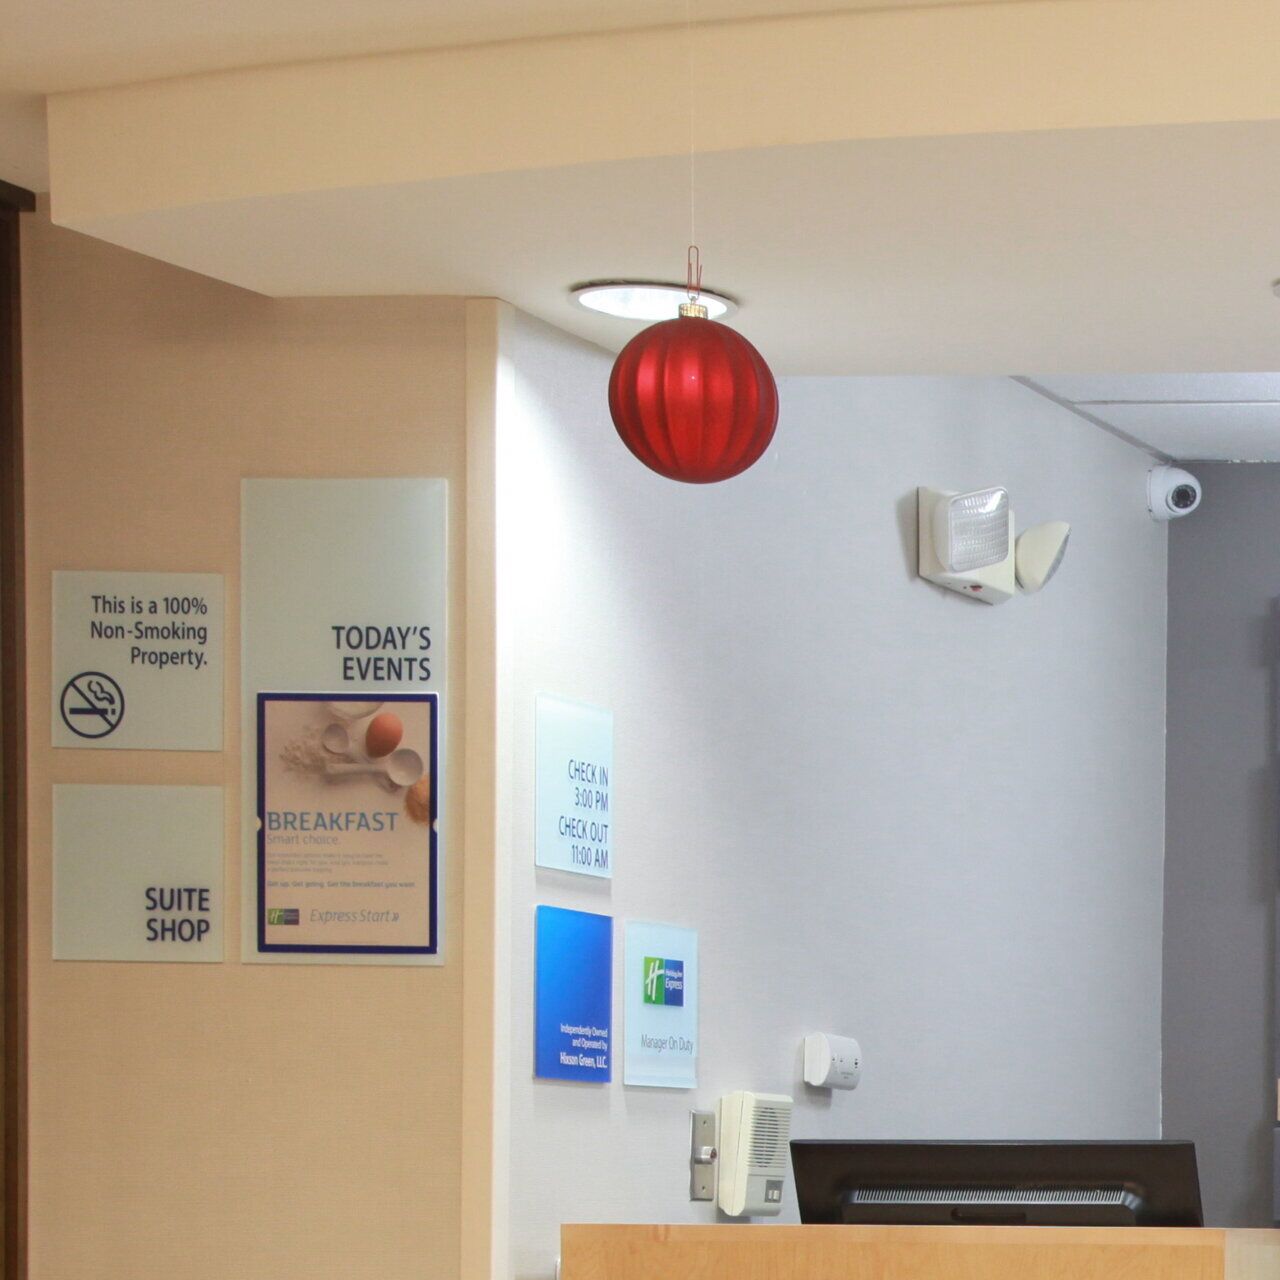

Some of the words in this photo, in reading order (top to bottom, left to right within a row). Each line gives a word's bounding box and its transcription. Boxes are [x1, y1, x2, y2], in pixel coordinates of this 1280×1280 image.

[91, 595, 125, 614] This
[131, 596, 143, 614] is
[149, 600, 157, 614] a
[163, 597, 207, 615] 100%
[90, 621, 207, 645] Non-Smoking
[331, 625, 431, 651] TODAY'S
[131, 646, 207, 670] Property.
[343, 656, 431, 681] EVENTS
[568, 759, 597, 784] CHECK
[599, 766, 608, 787] IN
[575, 786, 593, 809] 3:00
[595, 790, 608, 812] PM
[267, 811, 399, 832] BREAKFAST
[559, 815, 588, 840] CHECK
[590, 821, 608, 844] OUT
[267, 834, 300, 845] Smart
[572, 844, 592, 867] 11:00
[594, 848, 608, 869] AM
[145, 887, 210, 911] SUITE
[310, 909, 358, 926] Express
[360, 909, 390, 923] Start
[146, 918, 210, 942] SHOP
[640, 1033, 667, 1053] Manager
[669, 1035, 678, 1051] On
[679, 1037, 694, 1055] Duty
